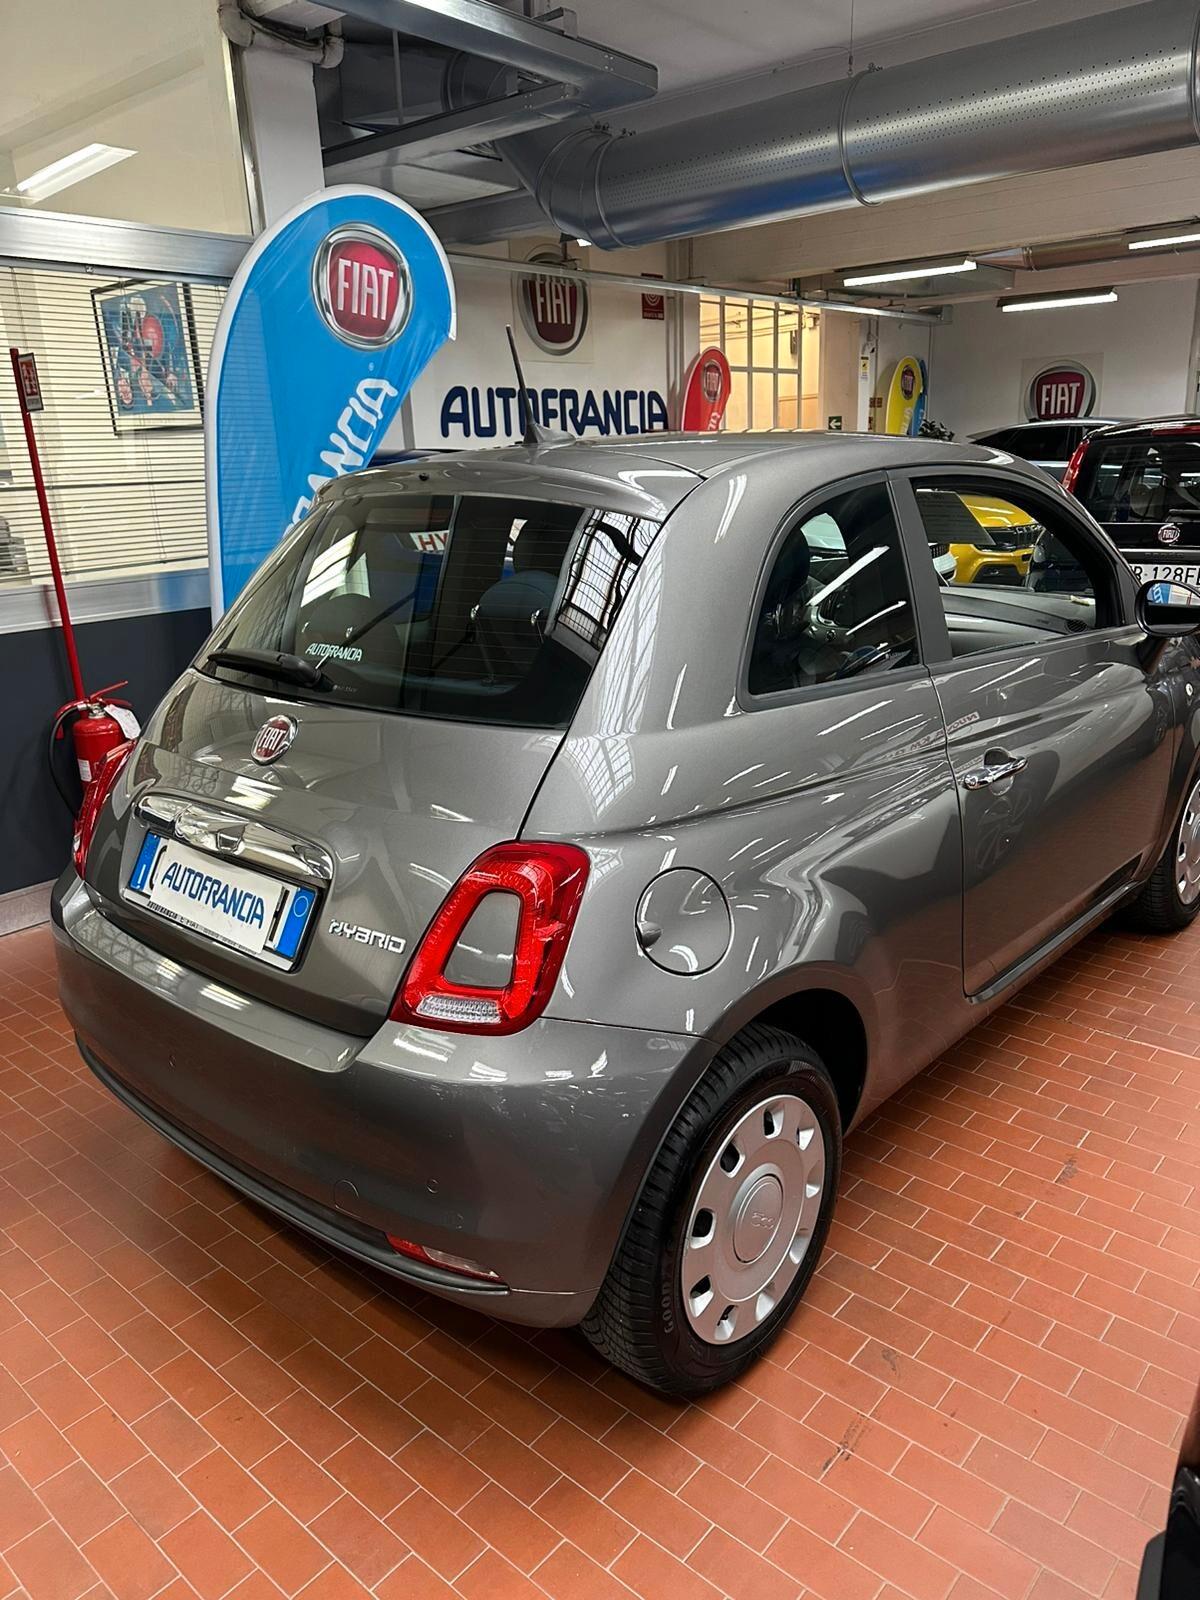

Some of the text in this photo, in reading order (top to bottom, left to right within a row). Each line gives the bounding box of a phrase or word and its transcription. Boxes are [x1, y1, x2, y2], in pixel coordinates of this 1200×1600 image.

[338, 258, 394, 320] FIAT
[535, 273, 574, 325] FIAT
[440, 386, 669, 438] AUTOFRANCIA
[1041, 383, 1080, 415] FIAT
[1163, 529, 1176, 539] FIAT
[259, 726, 287, 751] FIAT
[160, 861, 265, 929] AUTOFRANCIA
[328, 919, 406, 954] HYBRID
